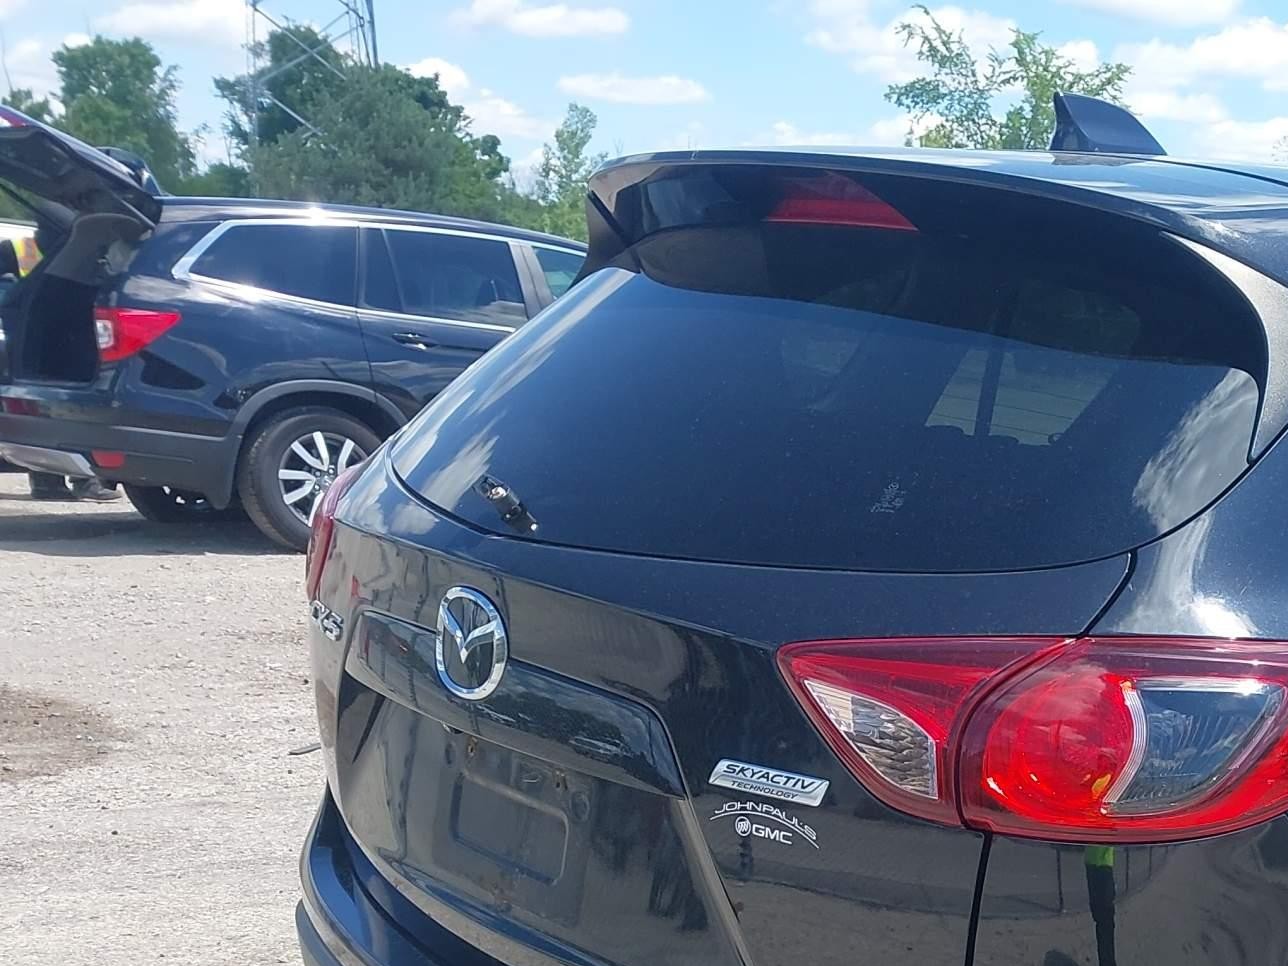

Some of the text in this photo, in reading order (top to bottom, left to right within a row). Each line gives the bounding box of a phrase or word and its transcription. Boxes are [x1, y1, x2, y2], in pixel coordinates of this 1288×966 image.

[722, 763, 816, 790] SKYACTIV
[730, 780, 799, 800] TECHNOLOGY
[752, 823, 793, 845] GMC
